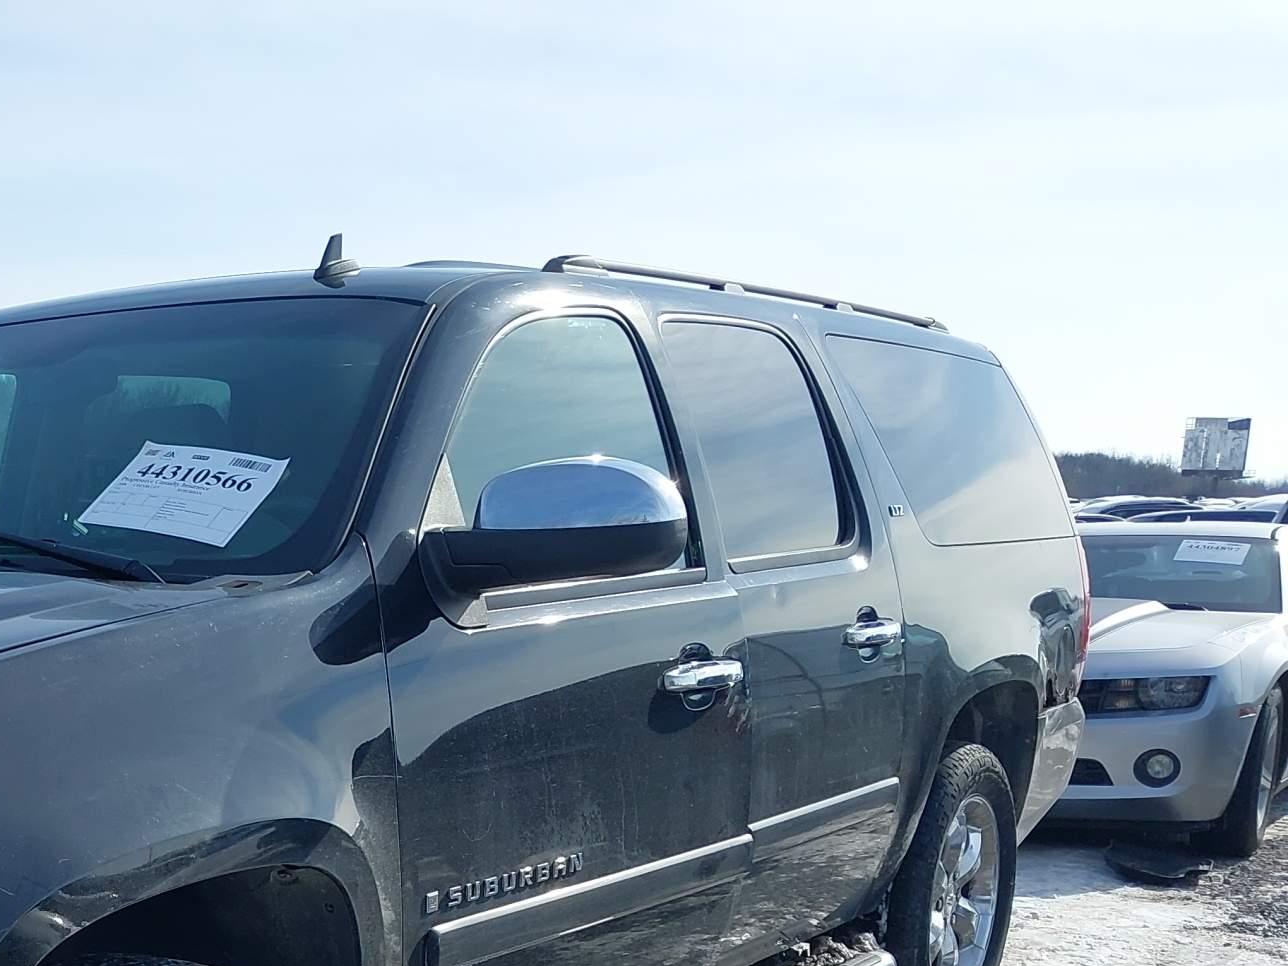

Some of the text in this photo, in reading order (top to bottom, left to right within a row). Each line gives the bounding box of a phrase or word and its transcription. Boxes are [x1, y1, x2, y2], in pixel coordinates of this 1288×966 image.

[136, 462, 260, 493] 44310566
[889, 504, 905, 518] LTZ
[447, 852, 584, 908] SUBURBAN
